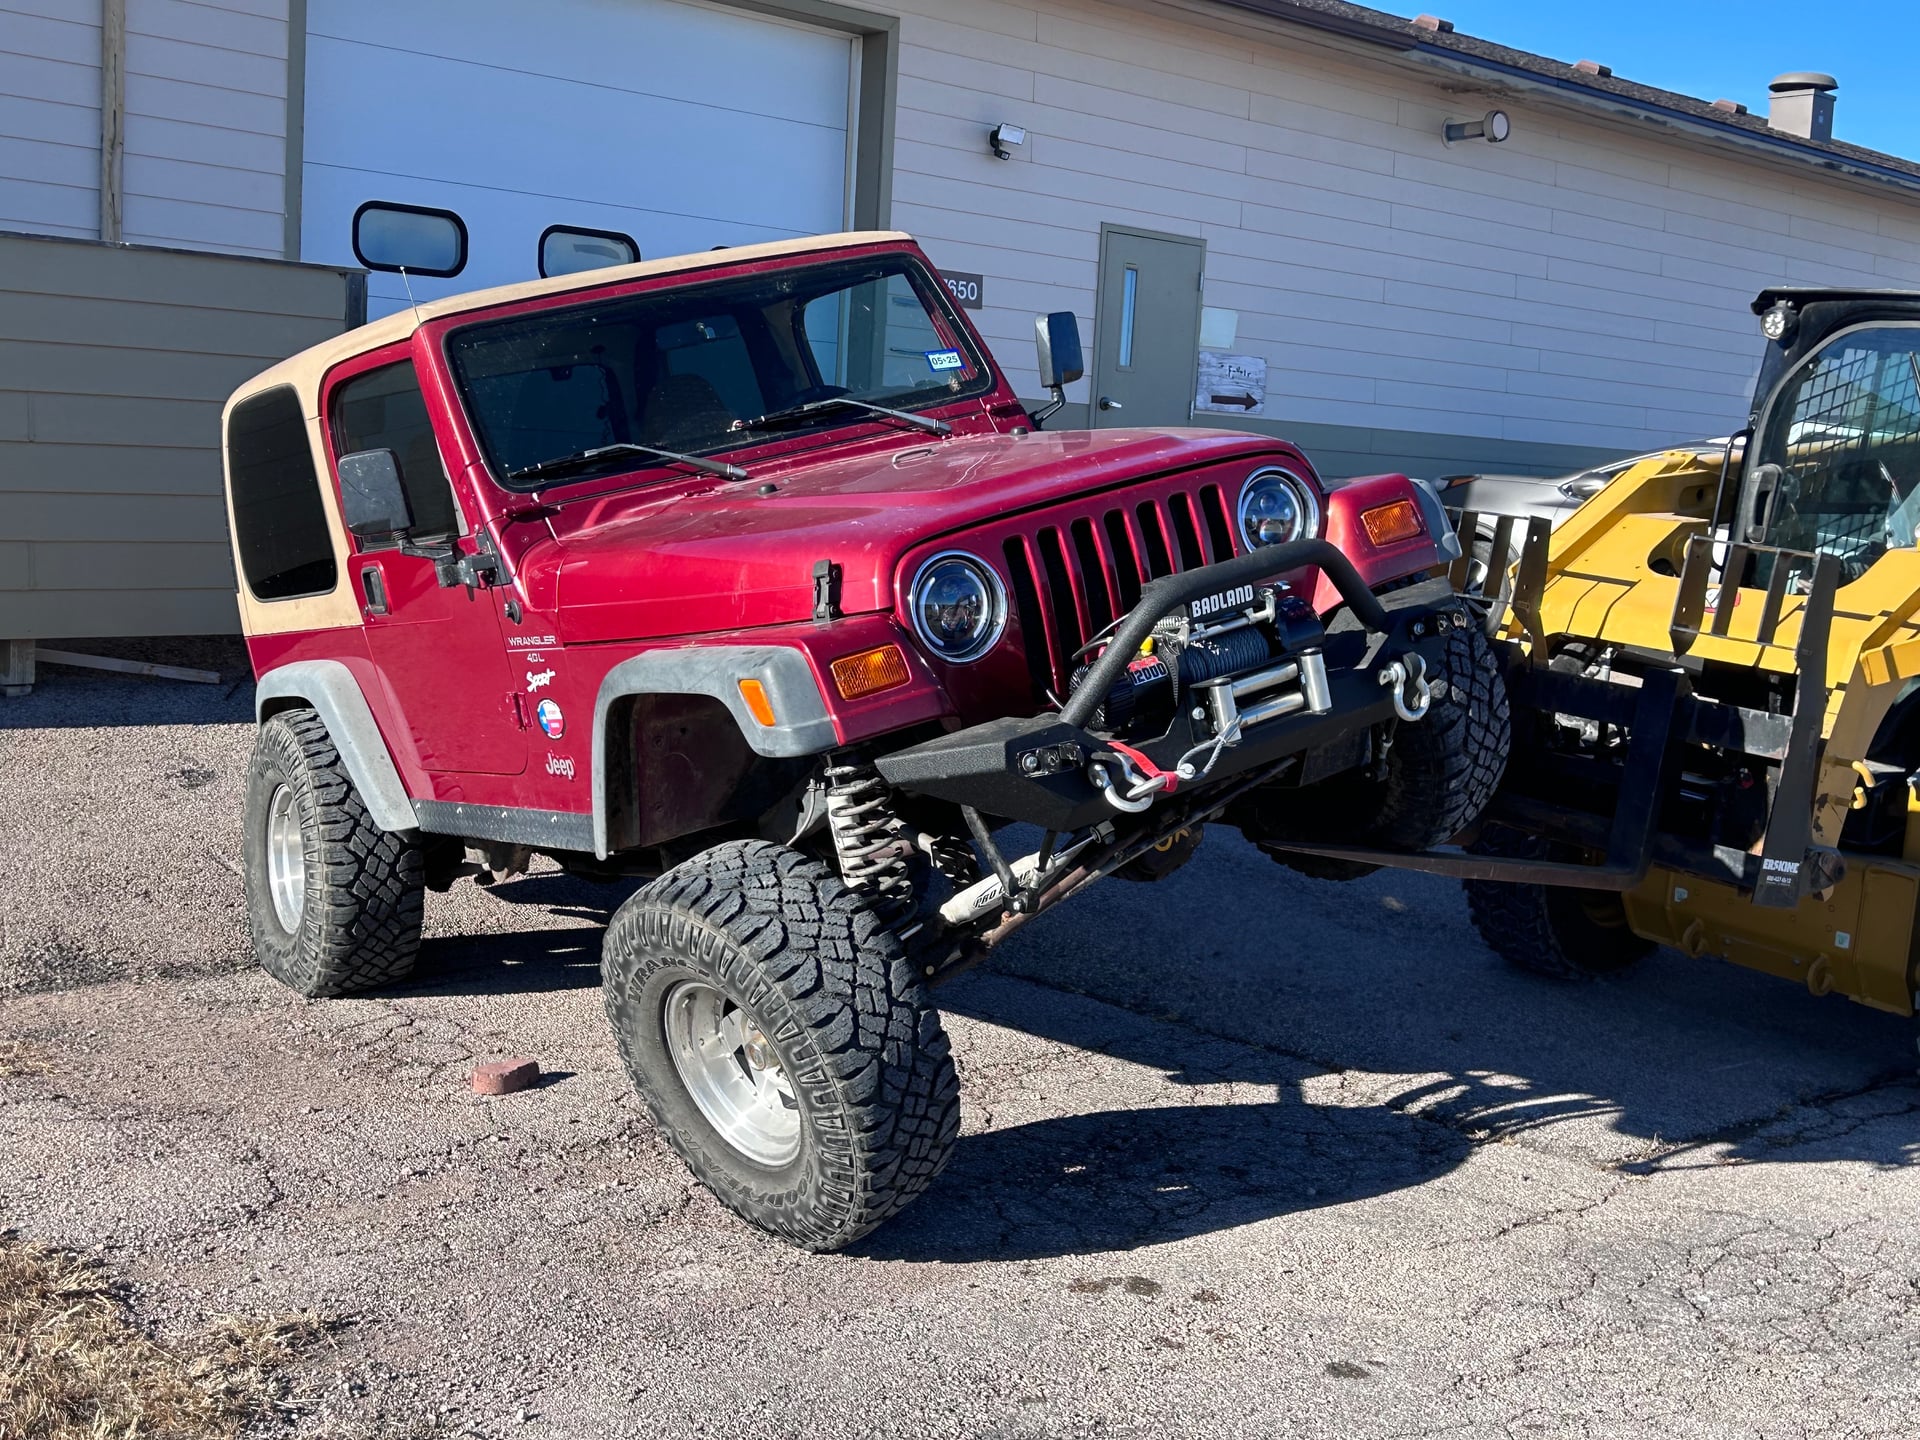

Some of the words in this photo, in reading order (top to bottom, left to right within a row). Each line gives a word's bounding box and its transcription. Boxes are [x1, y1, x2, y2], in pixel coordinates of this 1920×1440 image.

[944, 279, 978, 301] 650
[1191, 584, 1254, 618] BADLAND
[508, 635, 556, 646] WRANGLER
[1130, 662, 1168, 685] 12000
[545, 752, 574, 780] Jeep
[1762, 858, 1800, 874] ERSKINE
